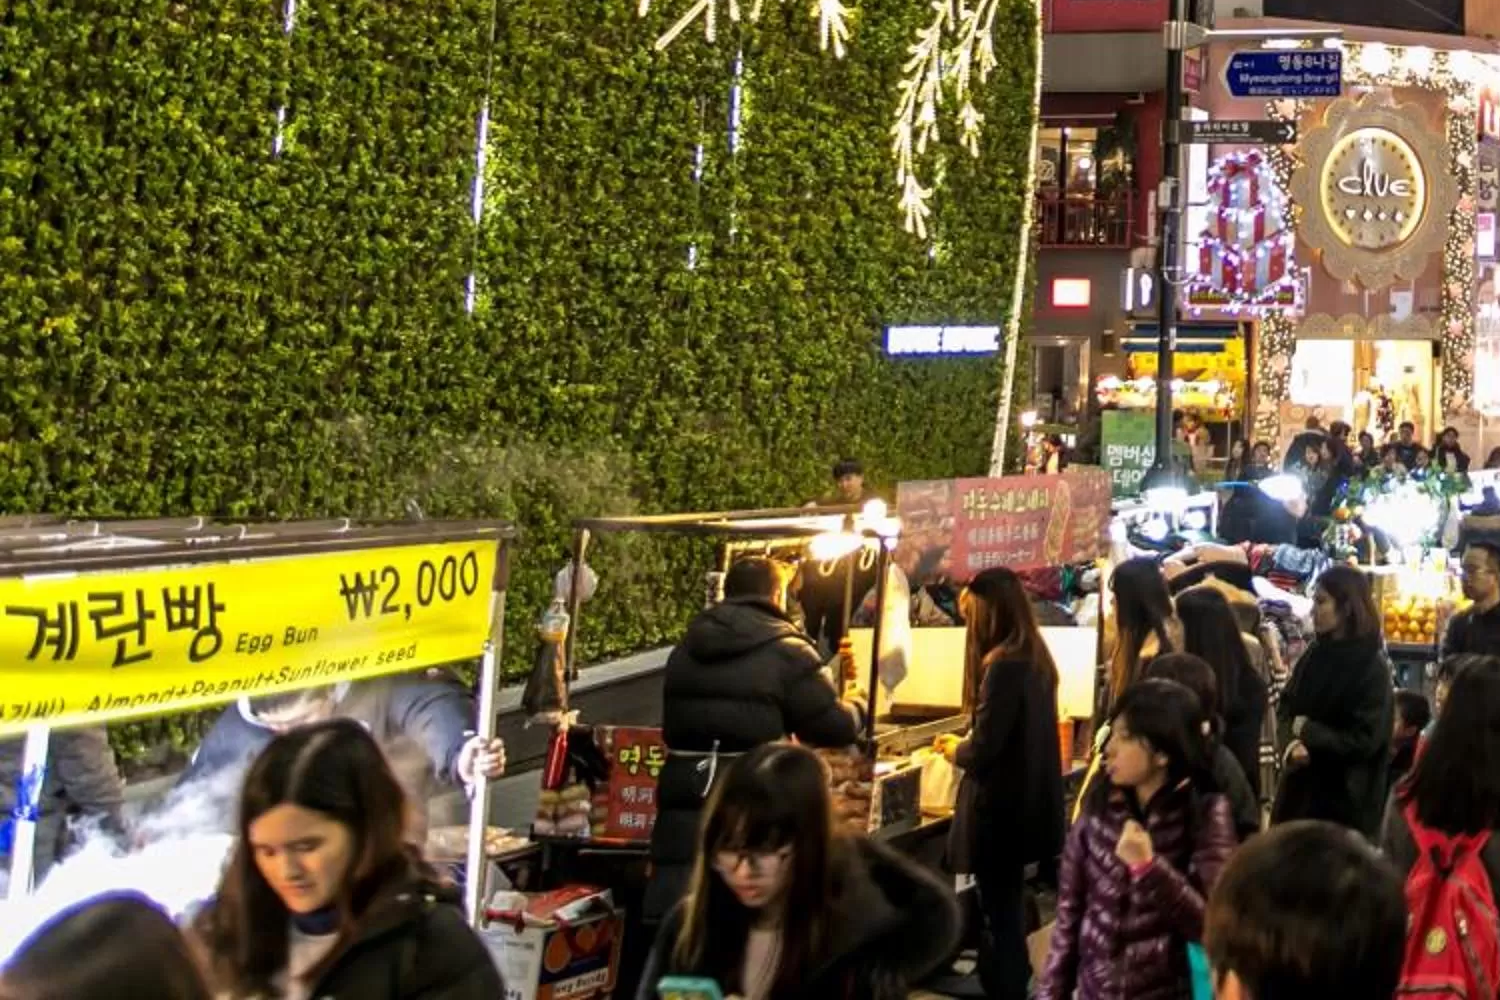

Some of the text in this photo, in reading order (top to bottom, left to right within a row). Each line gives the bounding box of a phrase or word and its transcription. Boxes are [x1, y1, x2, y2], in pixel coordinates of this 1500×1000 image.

[1338, 157, 1412, 197] clue
[1106, 444, 1156, 468] 멤버십
[339, 550, 480, 621] ₩2,000
[5, 581, 226, 669] 계란빵
[235, 626, 319, 654] Egg Bun
[375, 642, 417, 666] seed
[619, 744, 667, 777] 명동
